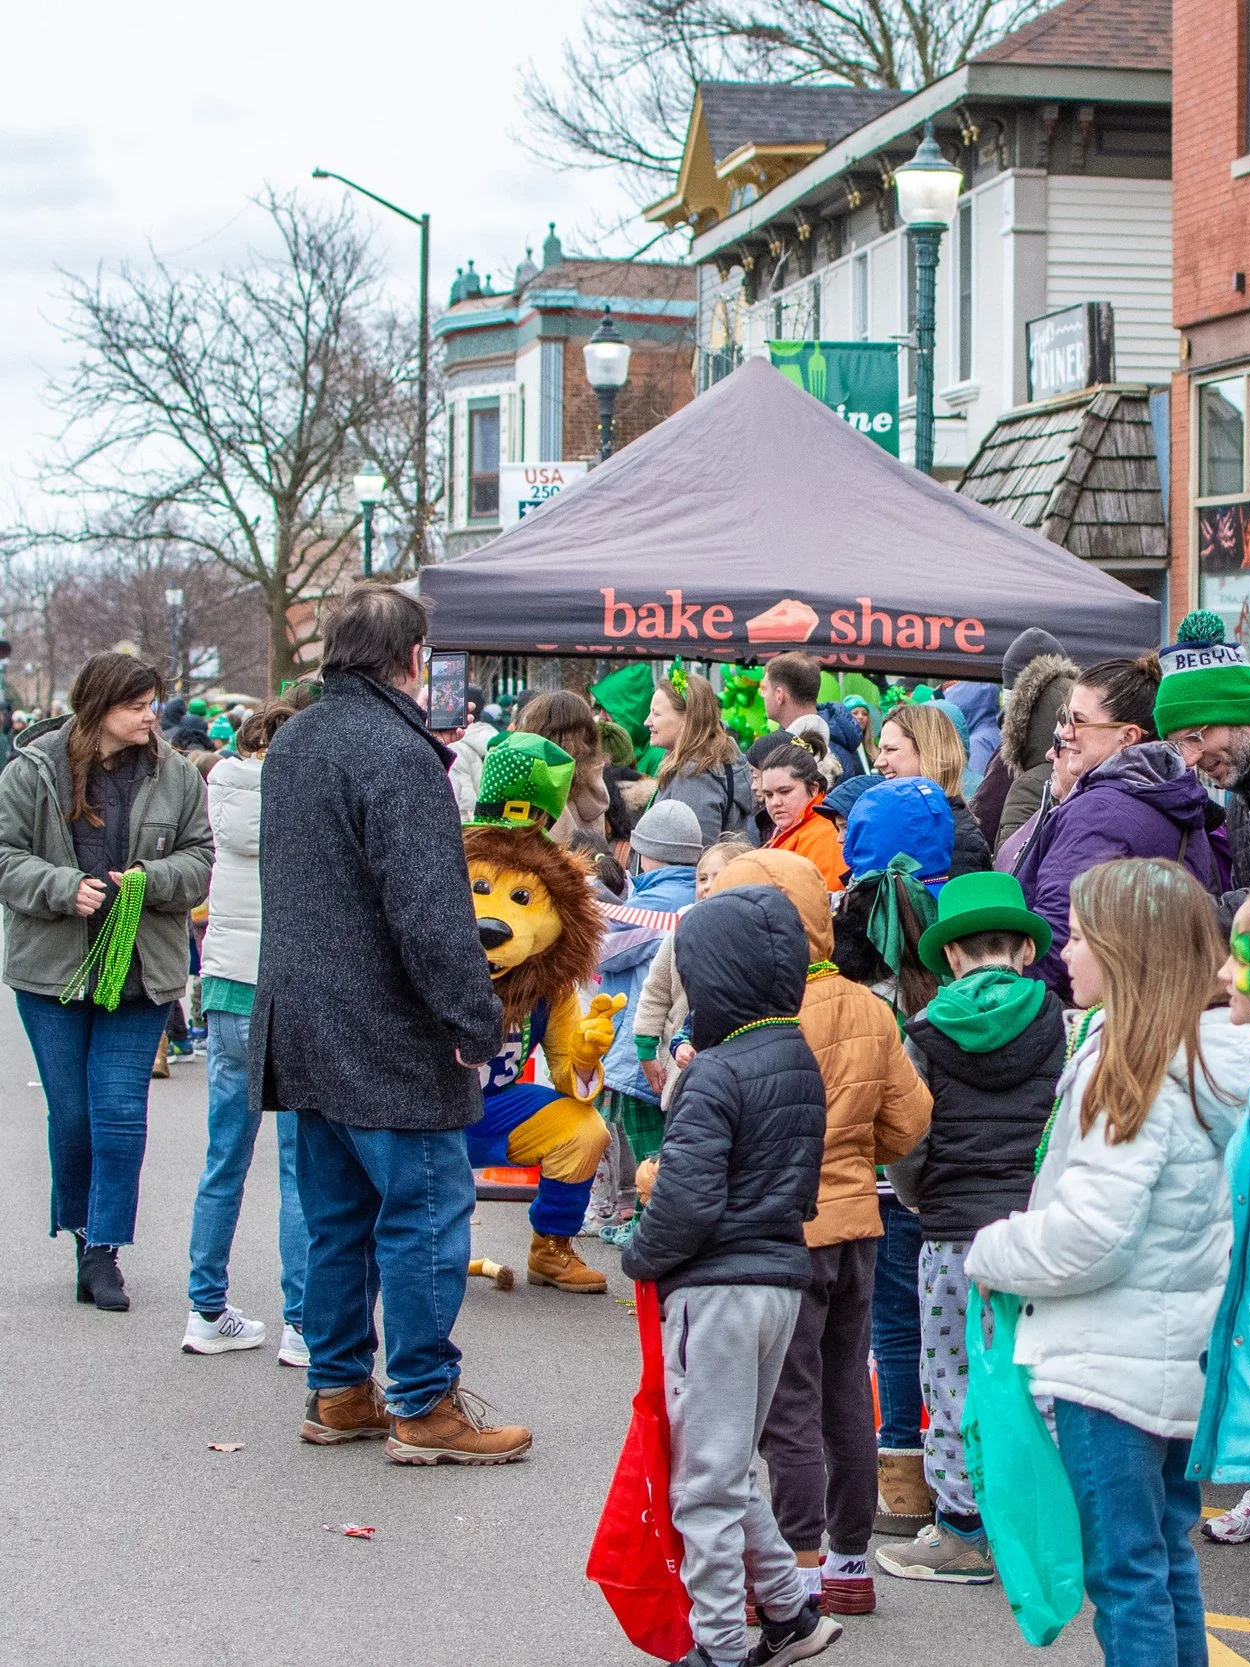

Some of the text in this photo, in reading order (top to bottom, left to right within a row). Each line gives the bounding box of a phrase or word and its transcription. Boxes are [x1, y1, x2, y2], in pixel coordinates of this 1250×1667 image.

[1040, 341, 1086, 390] DINER
[525, 468, 564, 484] USA
[600, 587, 986, 654] bake share
